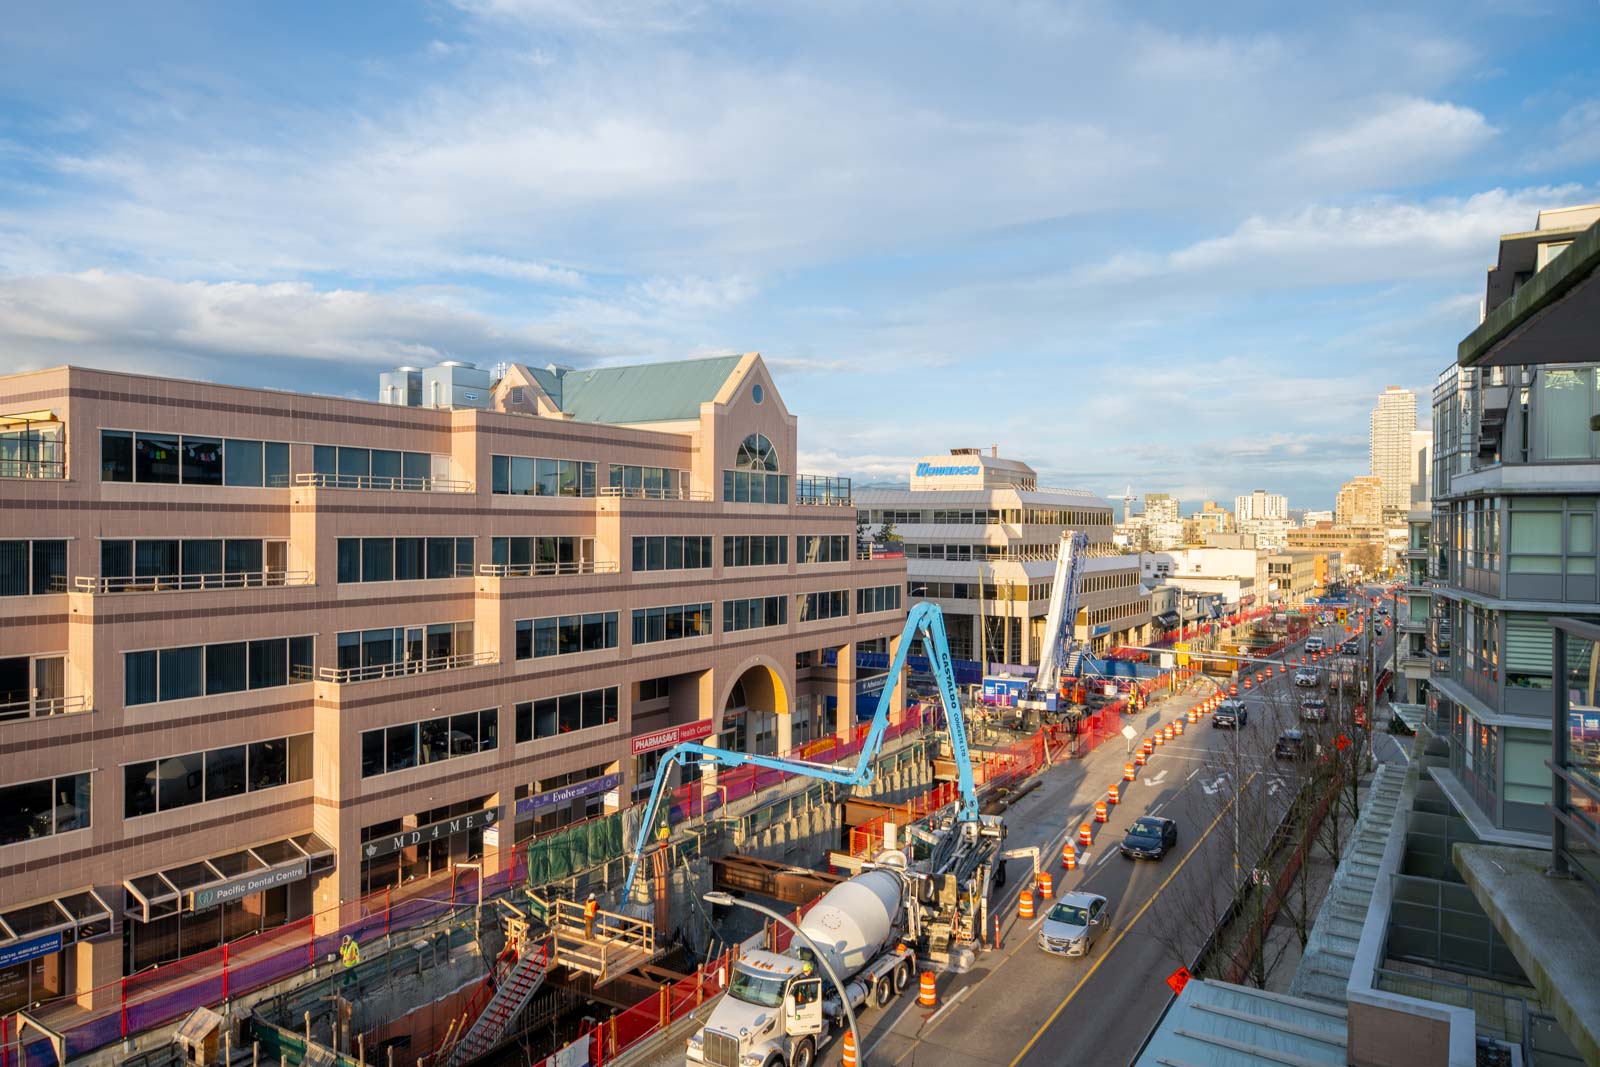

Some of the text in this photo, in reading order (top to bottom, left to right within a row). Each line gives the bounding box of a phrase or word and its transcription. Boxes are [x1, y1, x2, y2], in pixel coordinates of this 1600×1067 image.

[942, 653, 957, 709] GASTALDO
[954, 713, 963, 743] CONCRETE
[635, 724, 712, 750] PHARMASAVE Health Centre
[552, 789, 576, 802] Evolve
[393, 816, 473, 849] MD 4 ME
[217, 868, 303, 899] Pacific Dental Centre
